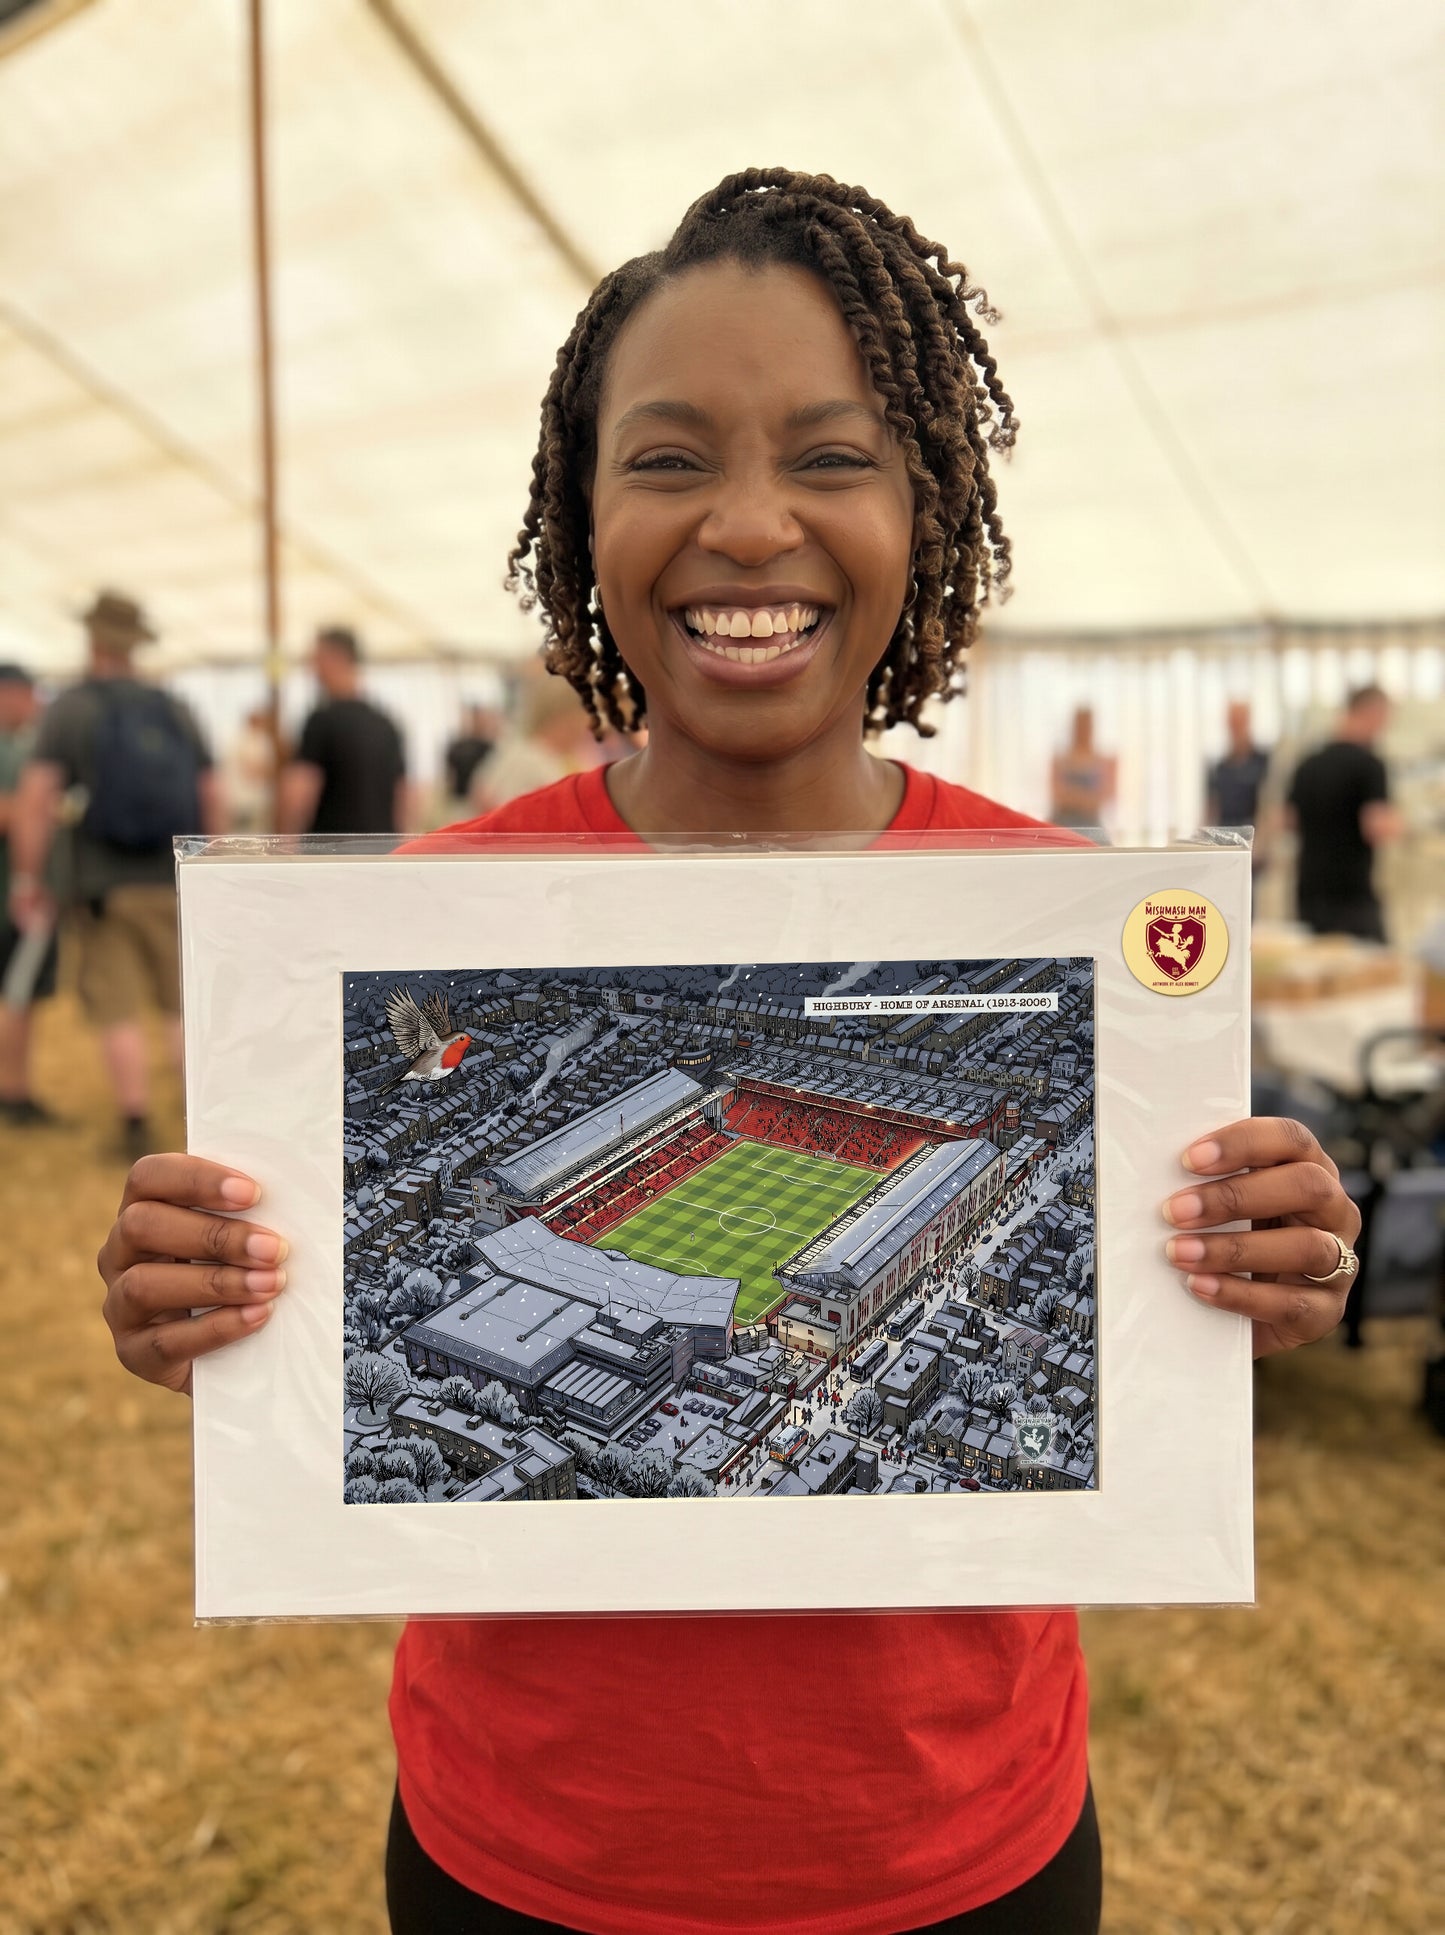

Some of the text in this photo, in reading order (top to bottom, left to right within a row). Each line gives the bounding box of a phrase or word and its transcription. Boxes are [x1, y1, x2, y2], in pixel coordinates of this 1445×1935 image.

[1145, 906, 1206, 915] MISHMASH MAN
[812, 1001, 873, 1011] HIGHBURY
[880, 1000, 913, 1010] HOME
[915, 1000, 930, 1009] OF
[931, 999, 985, 1009] ARSENAL
[986, 997, 1052, 1010] (1913-2006)
